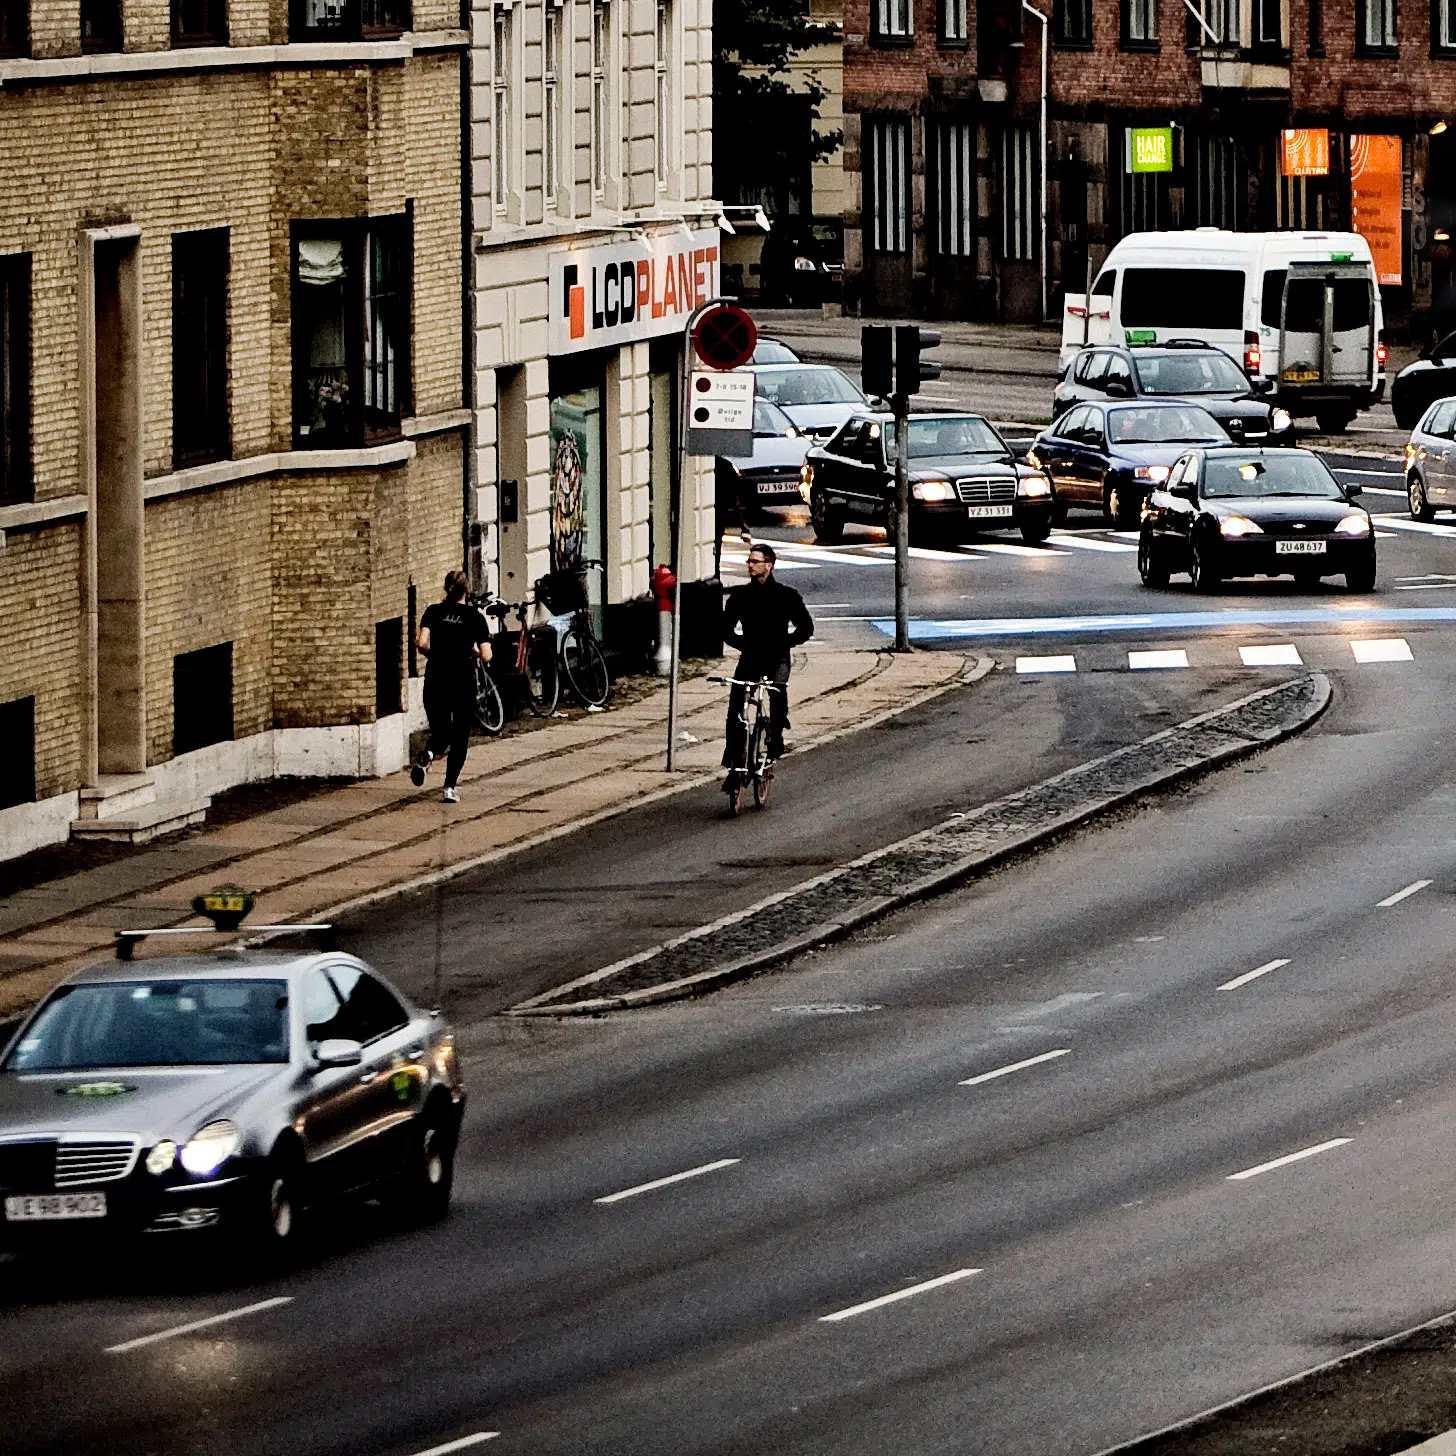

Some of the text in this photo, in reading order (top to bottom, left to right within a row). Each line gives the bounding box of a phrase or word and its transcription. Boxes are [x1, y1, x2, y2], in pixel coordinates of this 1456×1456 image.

[1136, 135, 1166, 154] HAIR
[1280, 542, 1293, 552] ZU
[1306, 542, 1323, 552] 637
